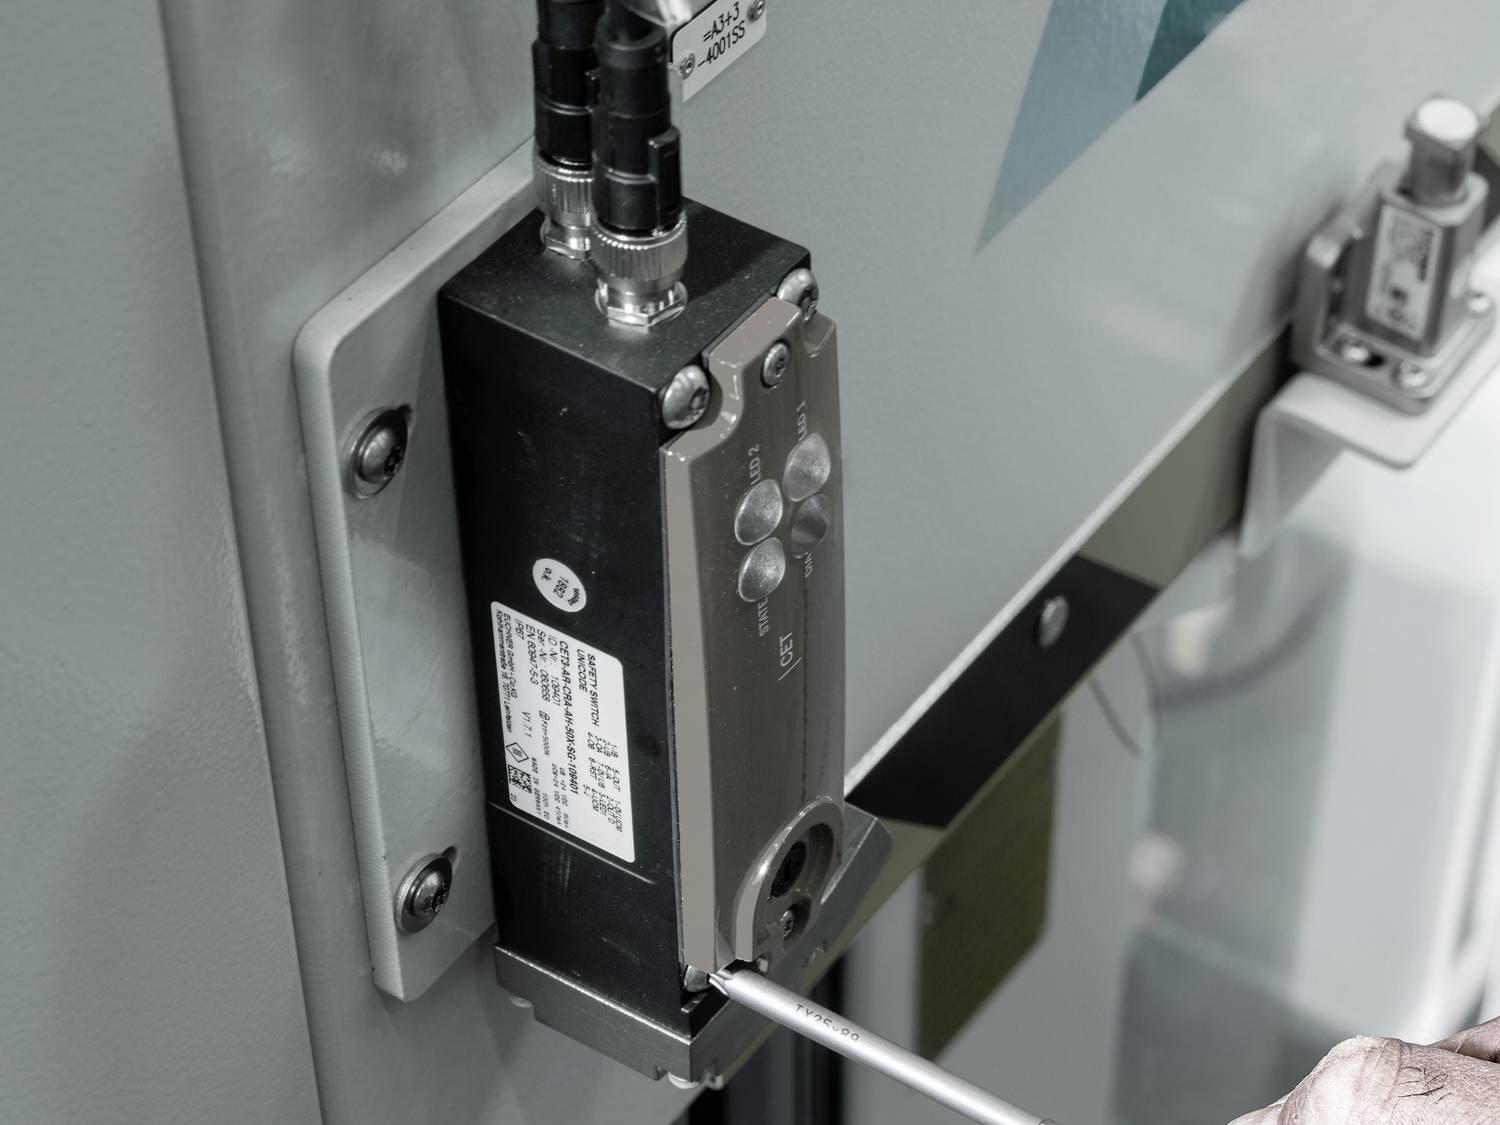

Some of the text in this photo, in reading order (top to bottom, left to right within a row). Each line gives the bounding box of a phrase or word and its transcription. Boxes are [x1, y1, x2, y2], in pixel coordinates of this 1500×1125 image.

[703, 1, 740, 42] =A3+3
[697, 20, 745, 67] -4001SS
[750, 458, 760, 485] LED
[514, 617, 524, 640] IP67
[525, 623, 539, 686] EN 60947-5-3
[576, 647, 587, 692] UNICODE
[550, 674, 561, 707] 109401
[587, 652, 599, 727] SAFETY SWITCH
